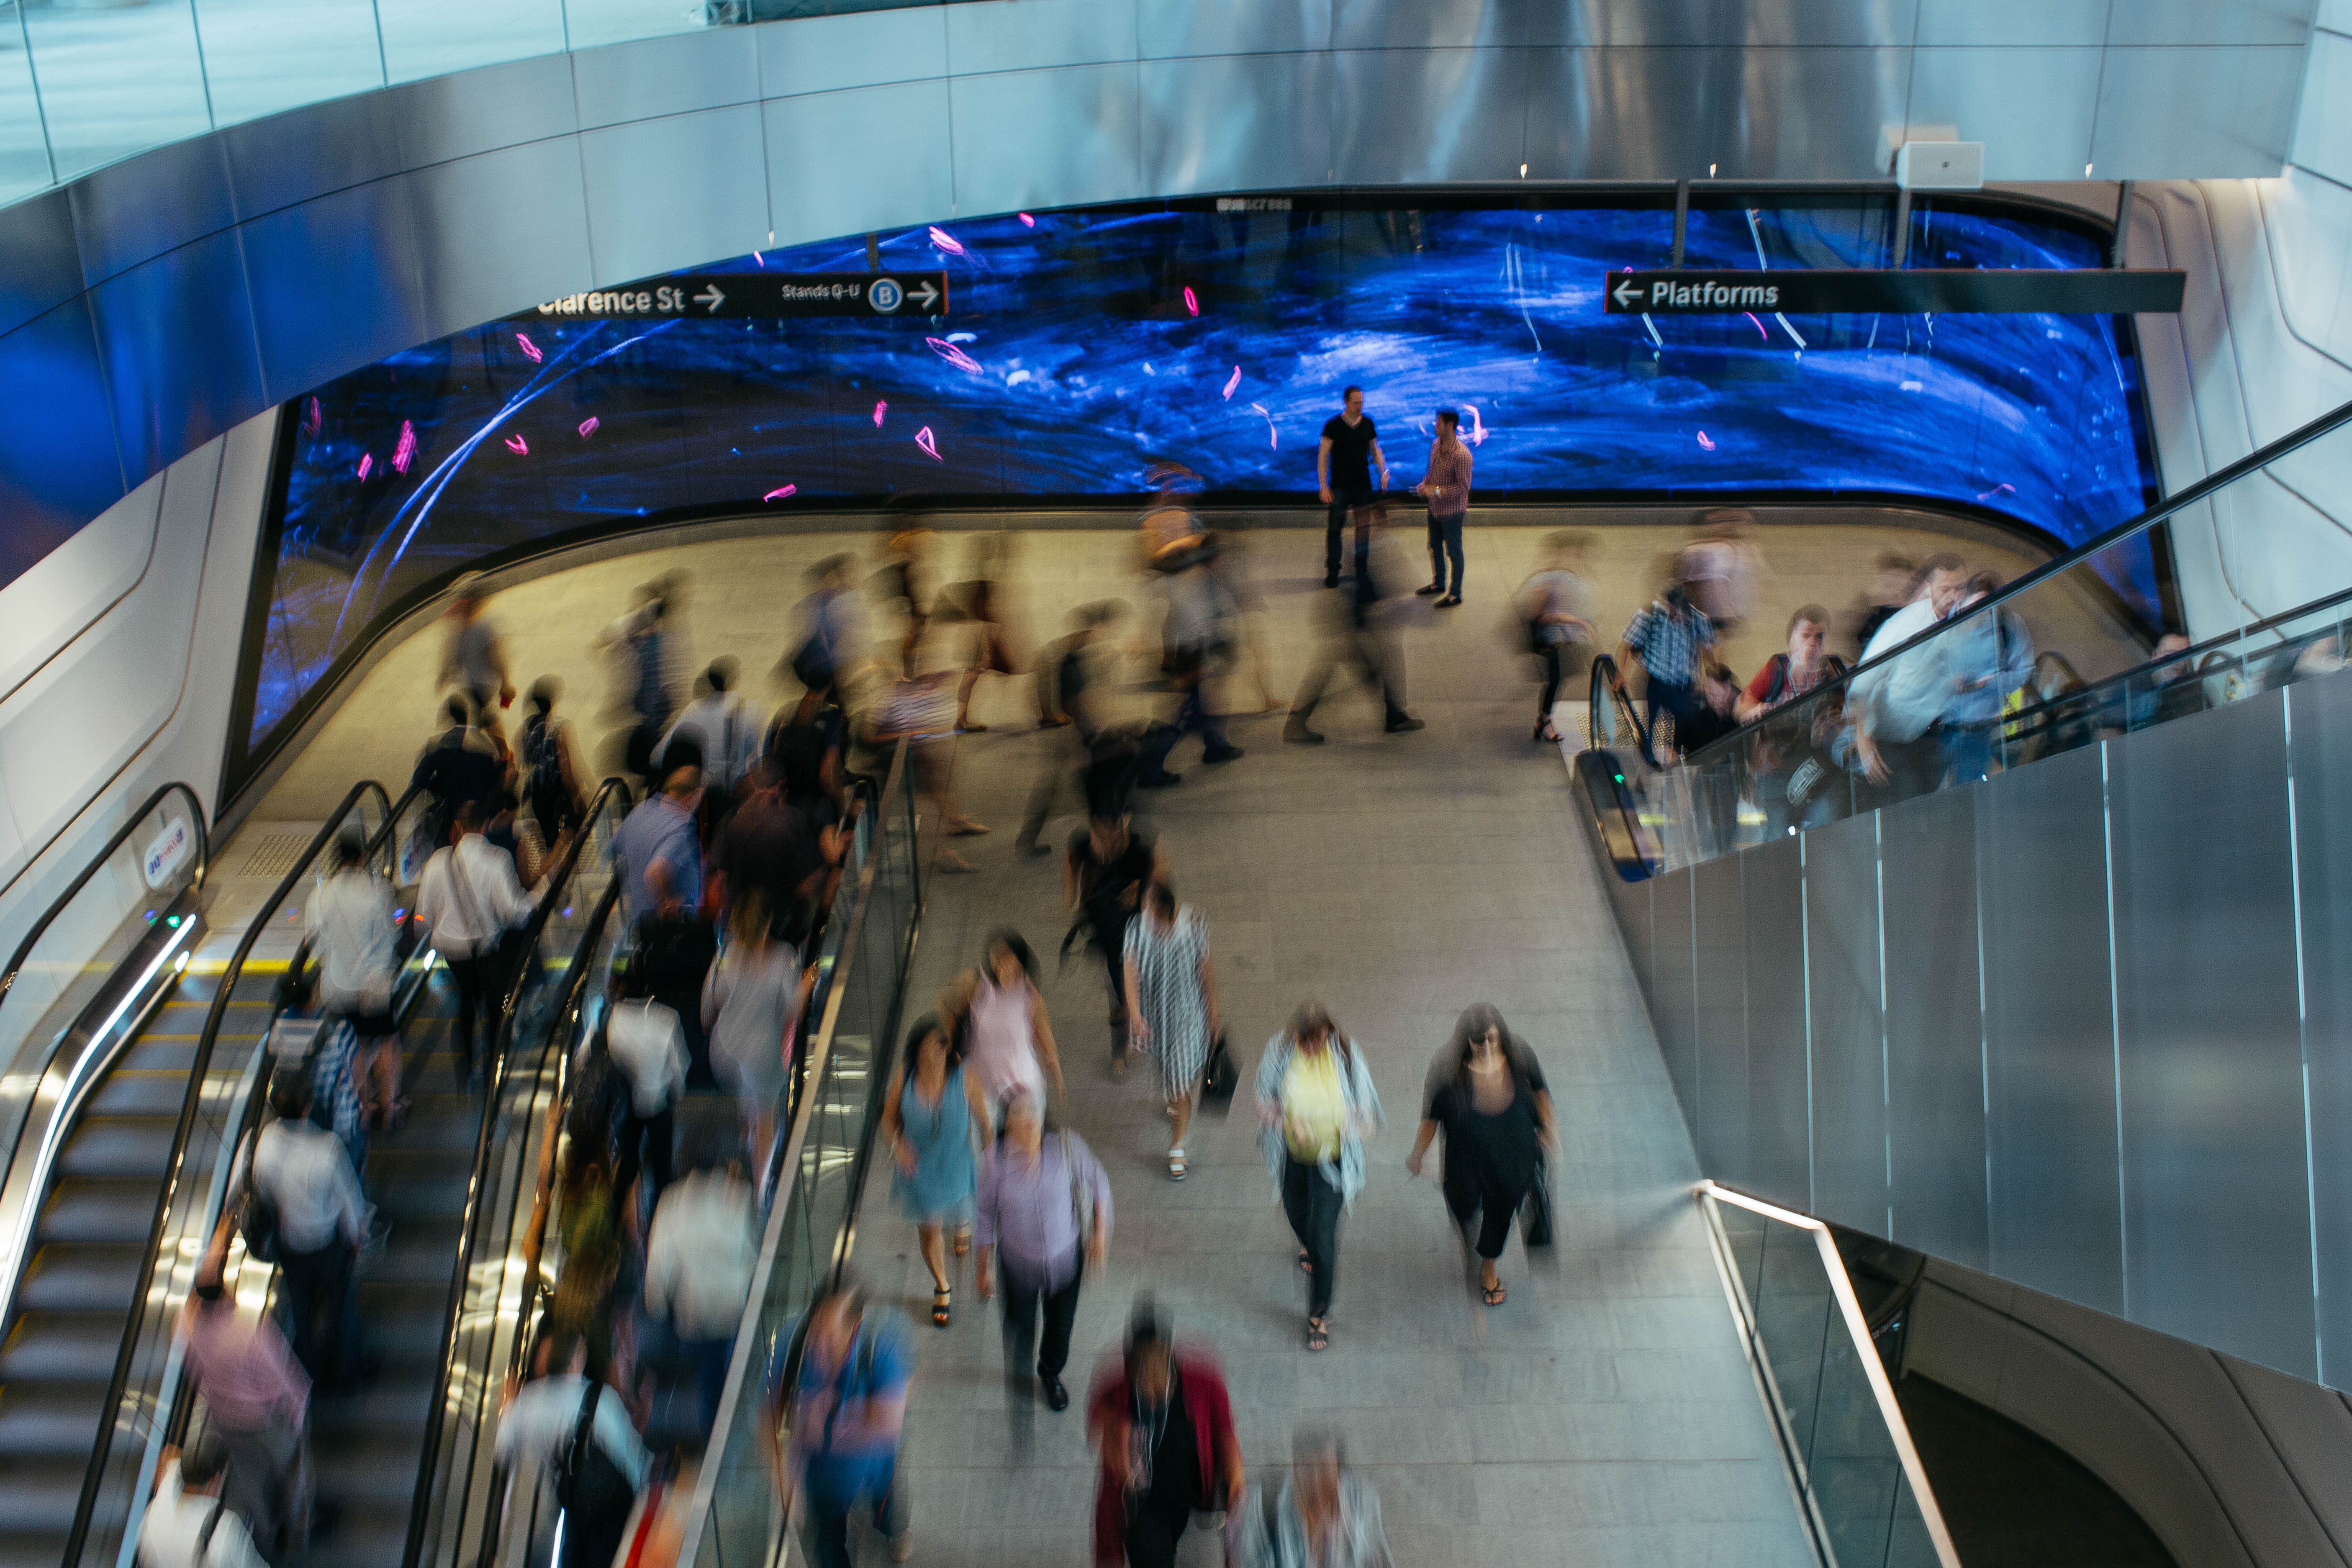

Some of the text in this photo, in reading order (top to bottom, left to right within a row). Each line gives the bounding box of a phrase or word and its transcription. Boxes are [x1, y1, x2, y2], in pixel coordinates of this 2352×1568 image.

[656, 286, 686, 312] St
[782, 284, 830, 300] Stands
[878, 287, 893, 305] B
[1652, 281, 1779, 307] Platforms
